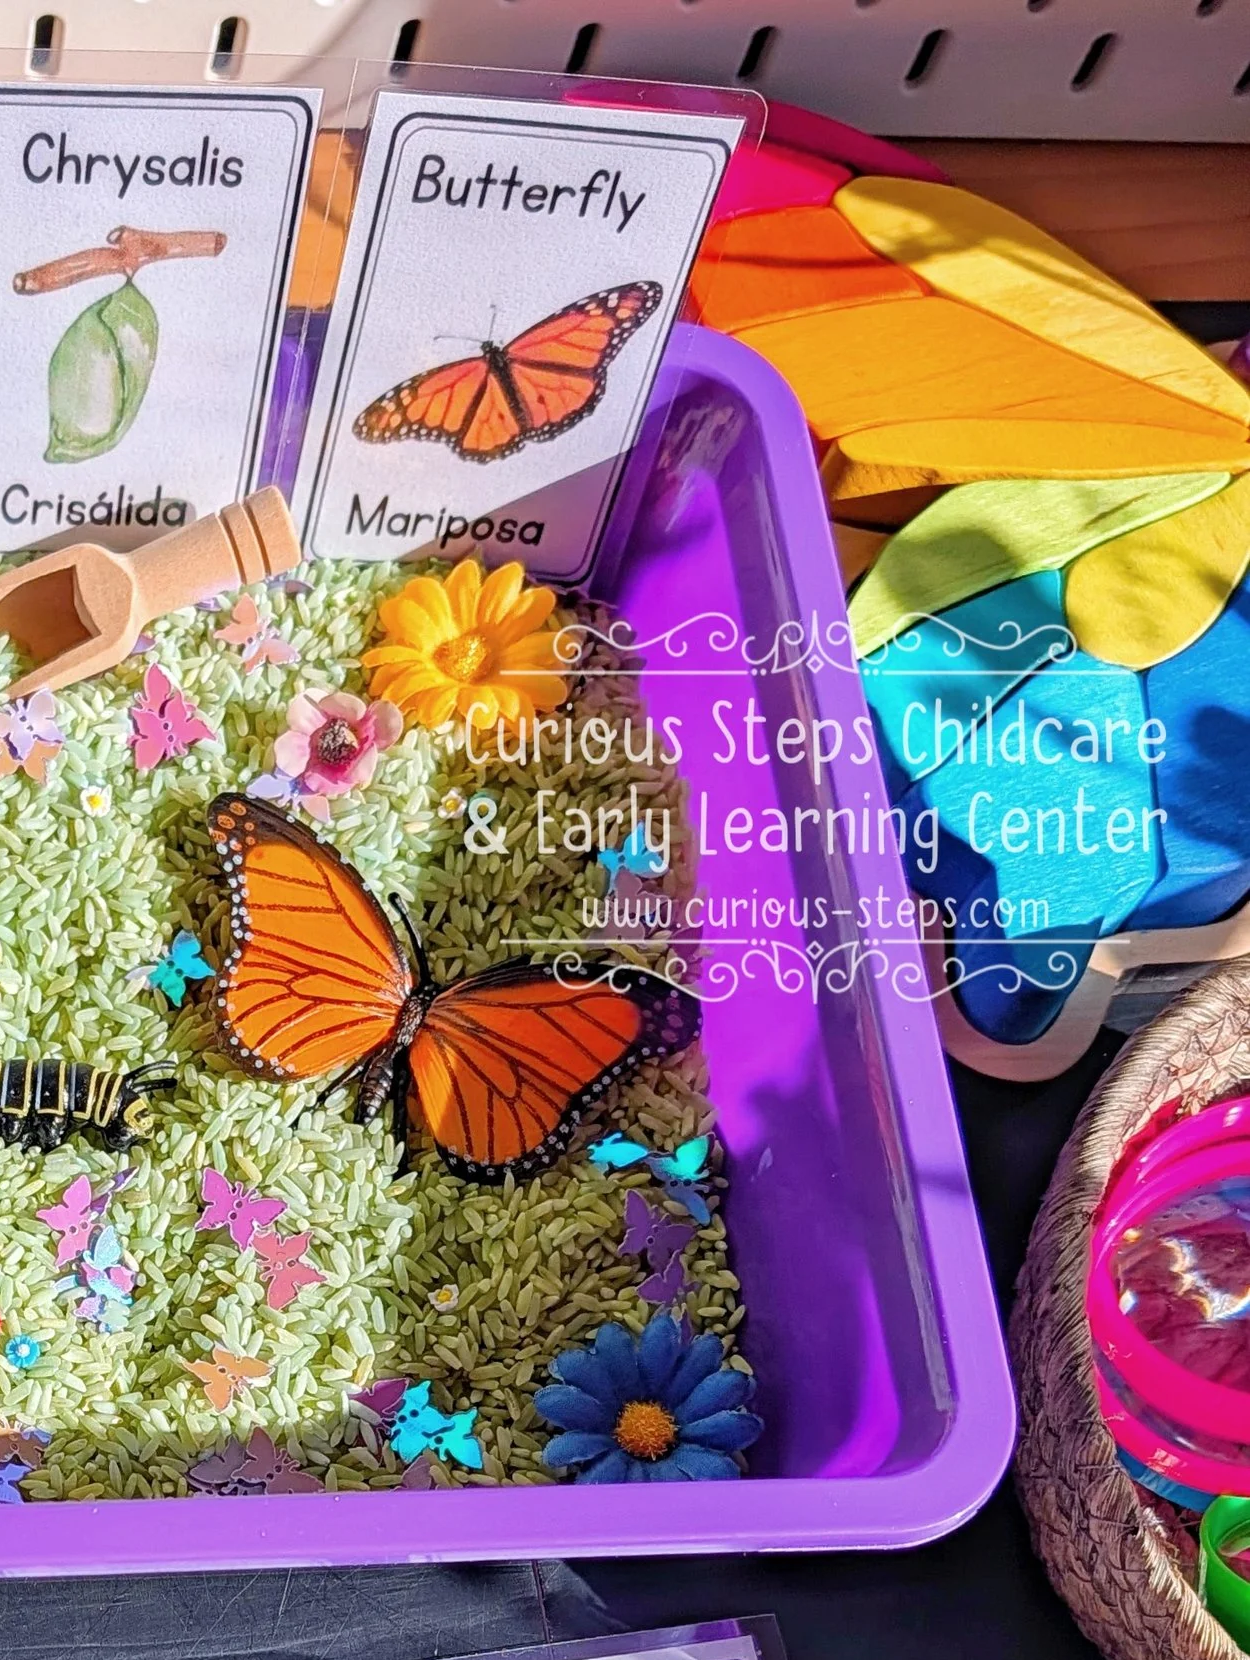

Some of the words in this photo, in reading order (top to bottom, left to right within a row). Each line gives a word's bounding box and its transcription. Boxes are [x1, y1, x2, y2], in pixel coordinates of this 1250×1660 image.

[22, 131, 245, 197] Chrysalis
[411, 154, 647, 234] Butterfly
[1, 485, 188, 529] Crisálida
[345, 493, 545, 549] Mariposa
